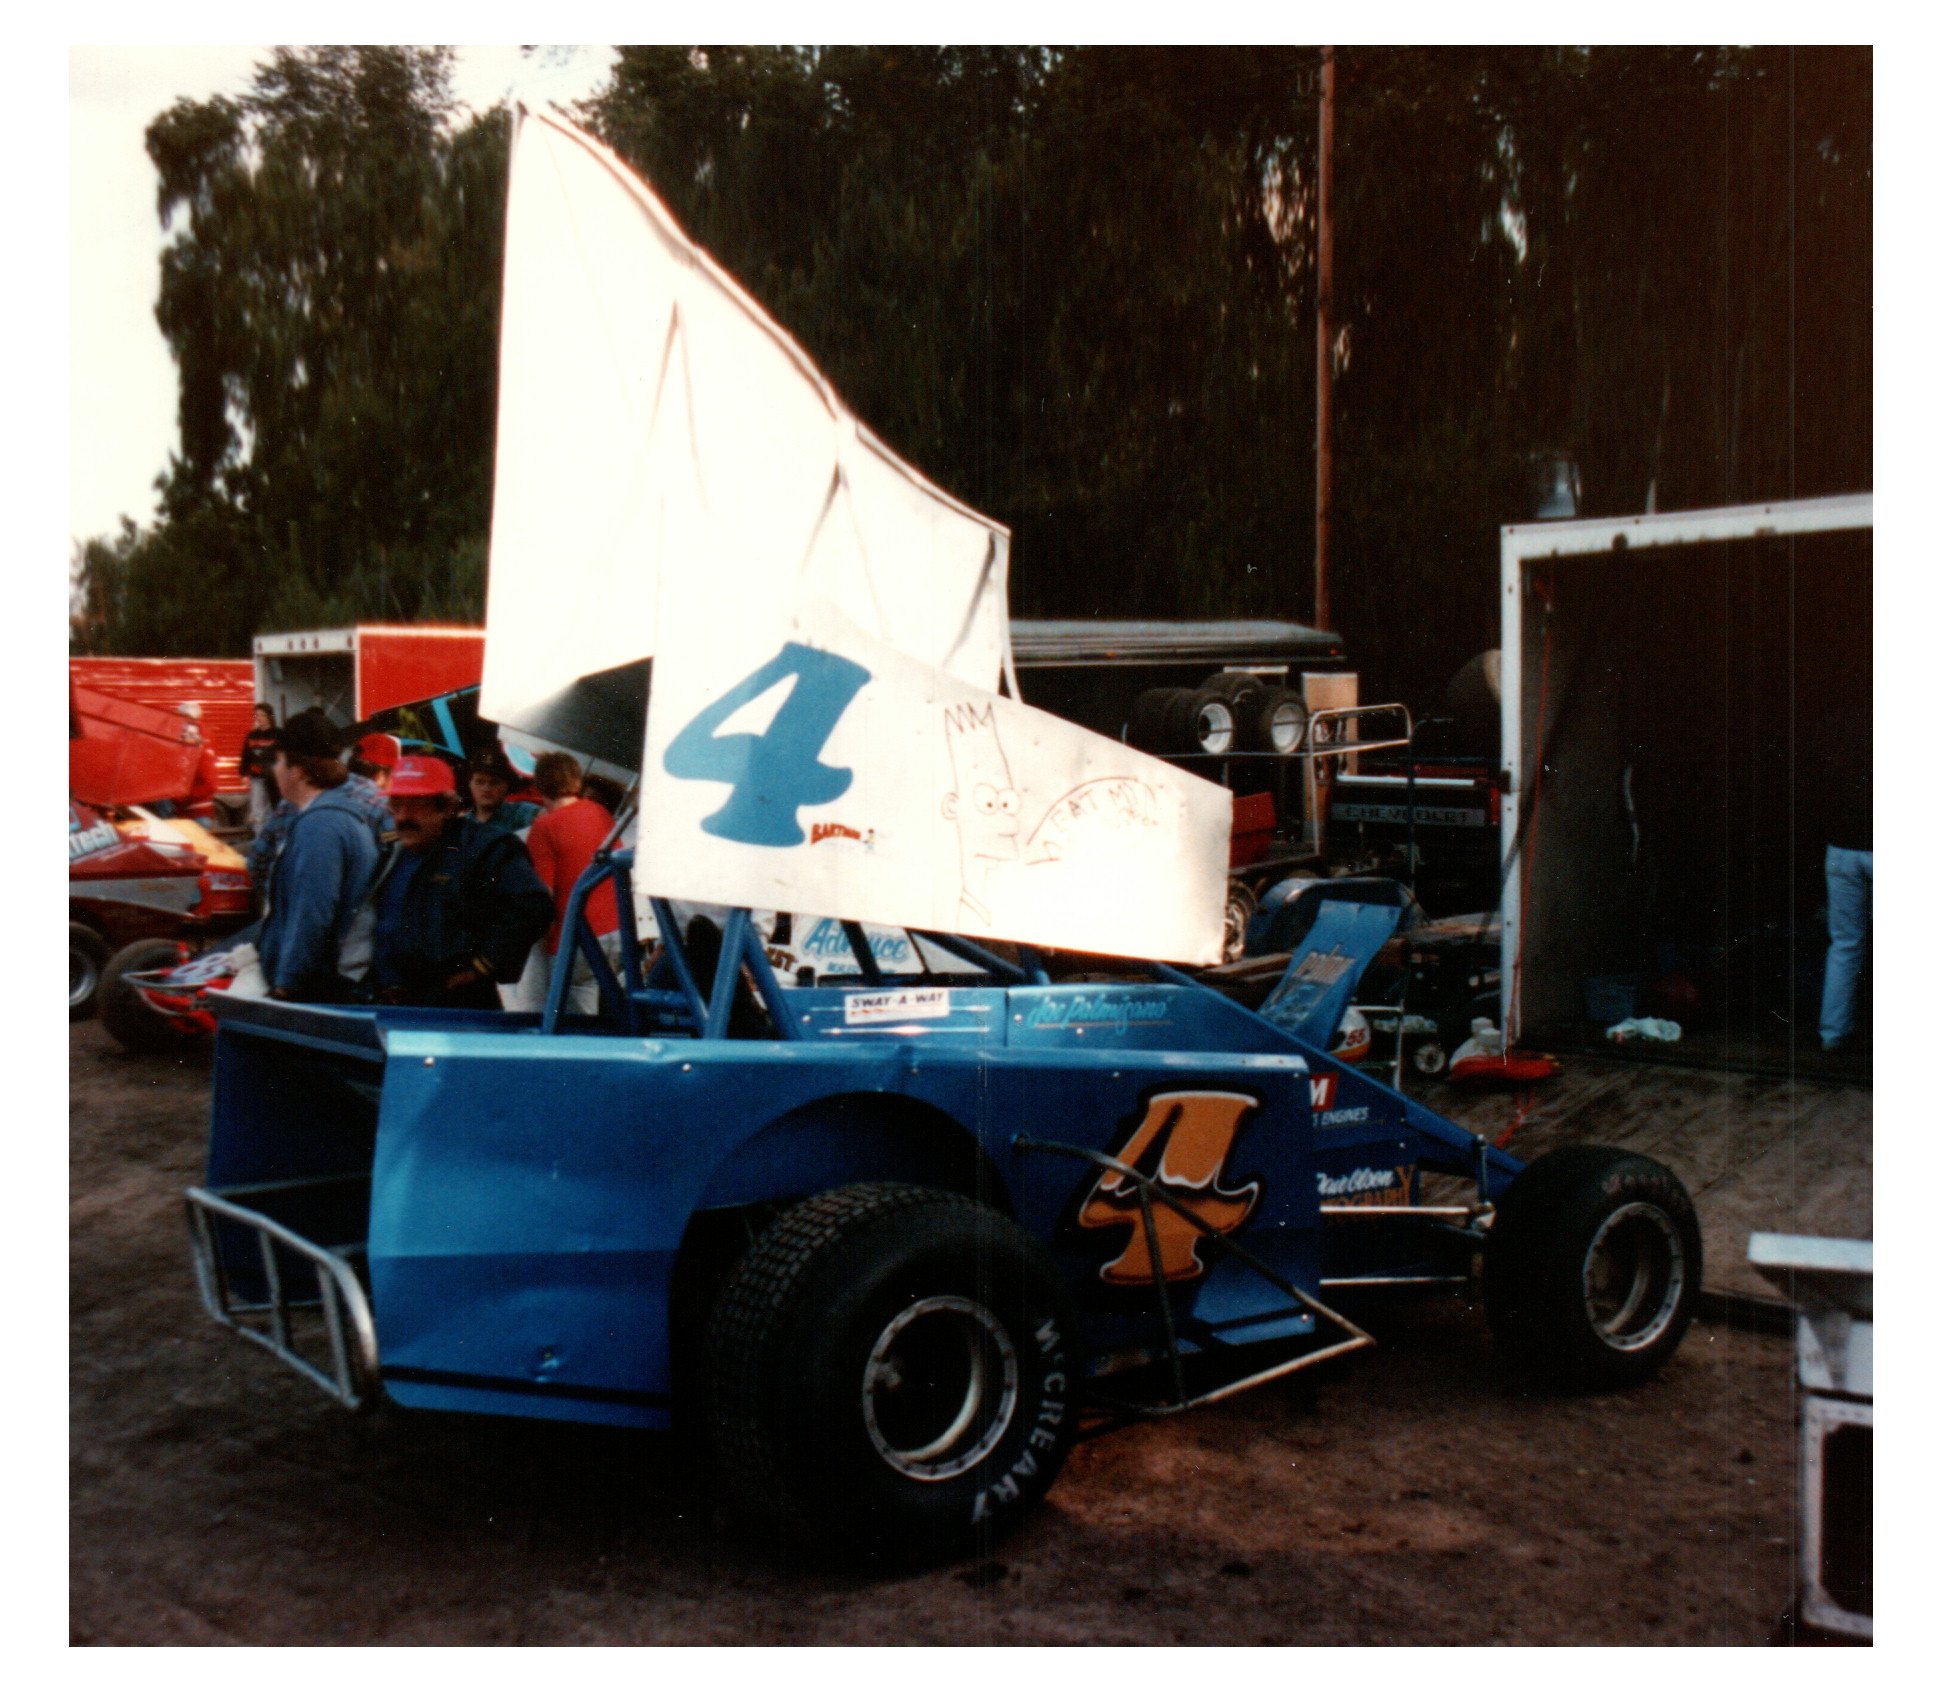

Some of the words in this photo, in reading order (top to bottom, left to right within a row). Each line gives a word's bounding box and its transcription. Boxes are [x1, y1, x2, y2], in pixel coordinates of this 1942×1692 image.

[663, 641, 872, 848] 4
[851, 996, 892, 1008] SWAY
[915, 991, 944, 1003] WAY
[1320, 1106, 1370, 1126] ENGINES
[1078, 1089, 1260, 1285] 4
